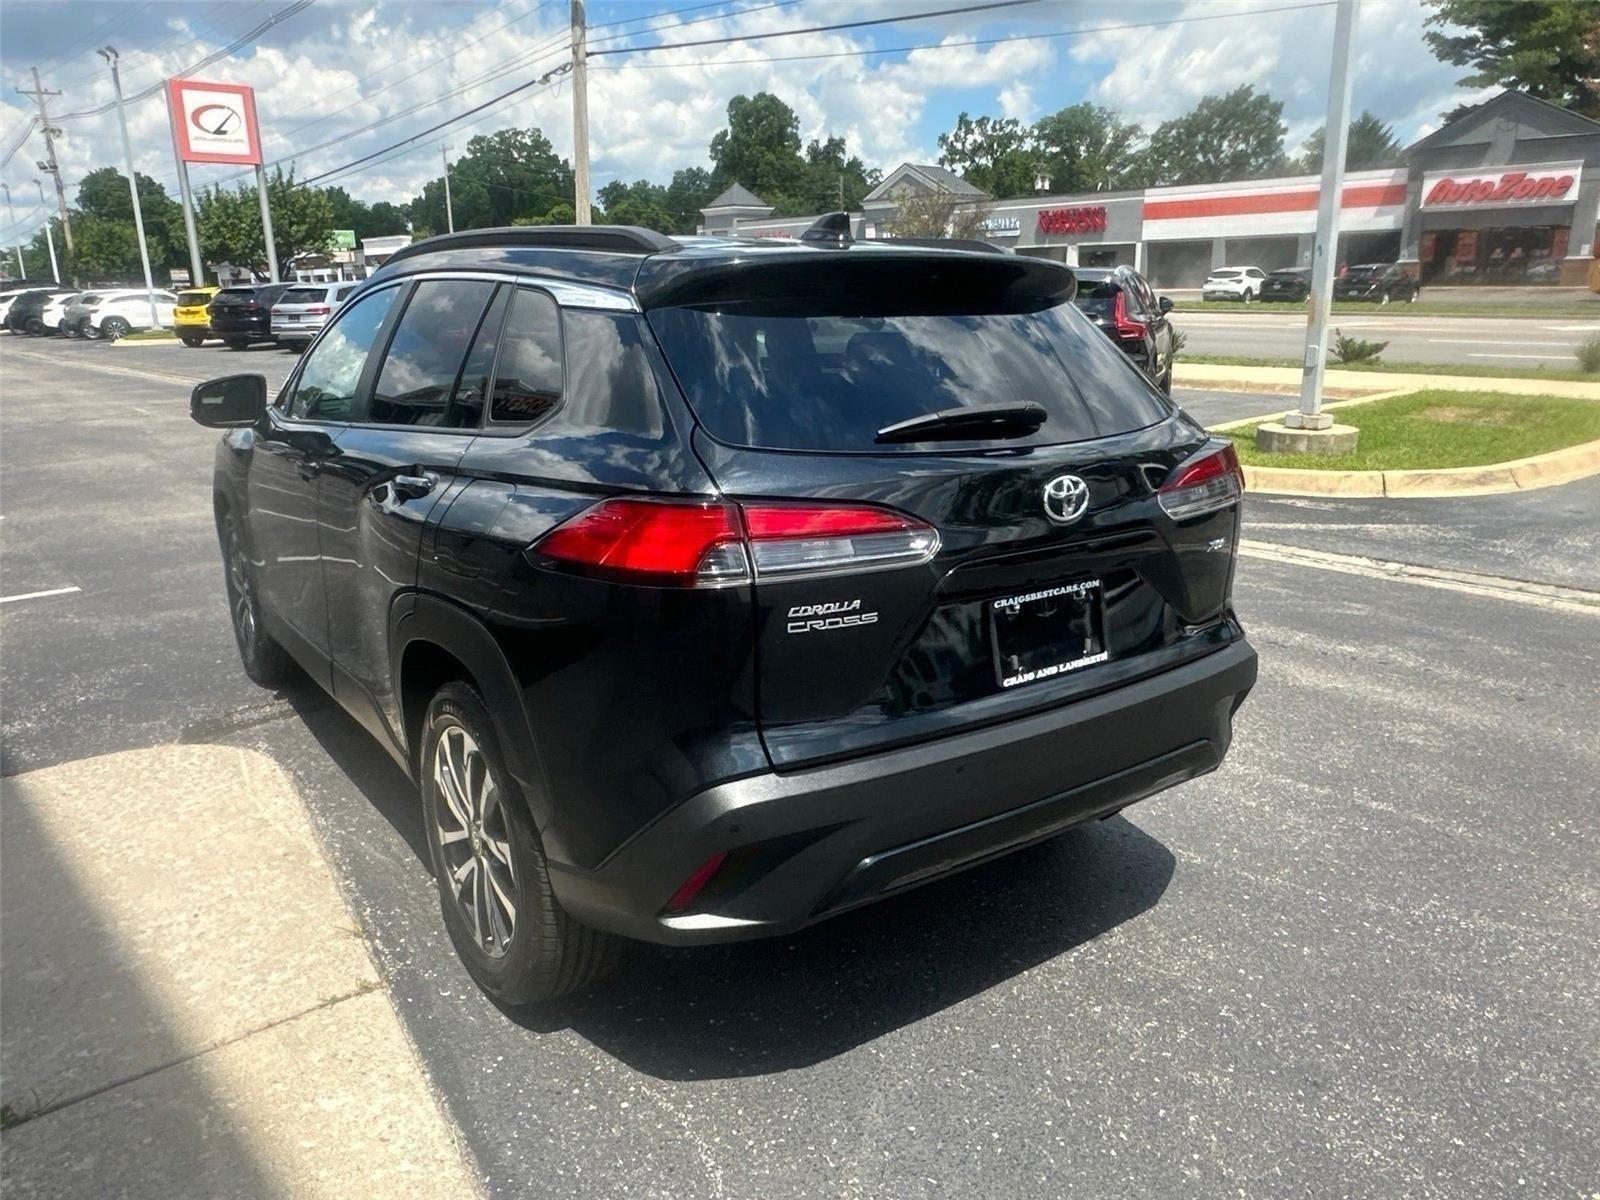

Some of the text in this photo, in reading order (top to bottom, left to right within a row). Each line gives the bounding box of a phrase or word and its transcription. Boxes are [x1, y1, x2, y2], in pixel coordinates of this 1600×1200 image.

[1425, 172, 1575, 204] AutoZone
[994, 580, 1100, 609] CRAIGSBESTCARS.COM
[787, 599, 861, 617] COROLLA
[787, 612, 878, 634] CROSS
[1003, 672, 1035, 687] CRAIG
[1036, 665, 1058, 678] AND
